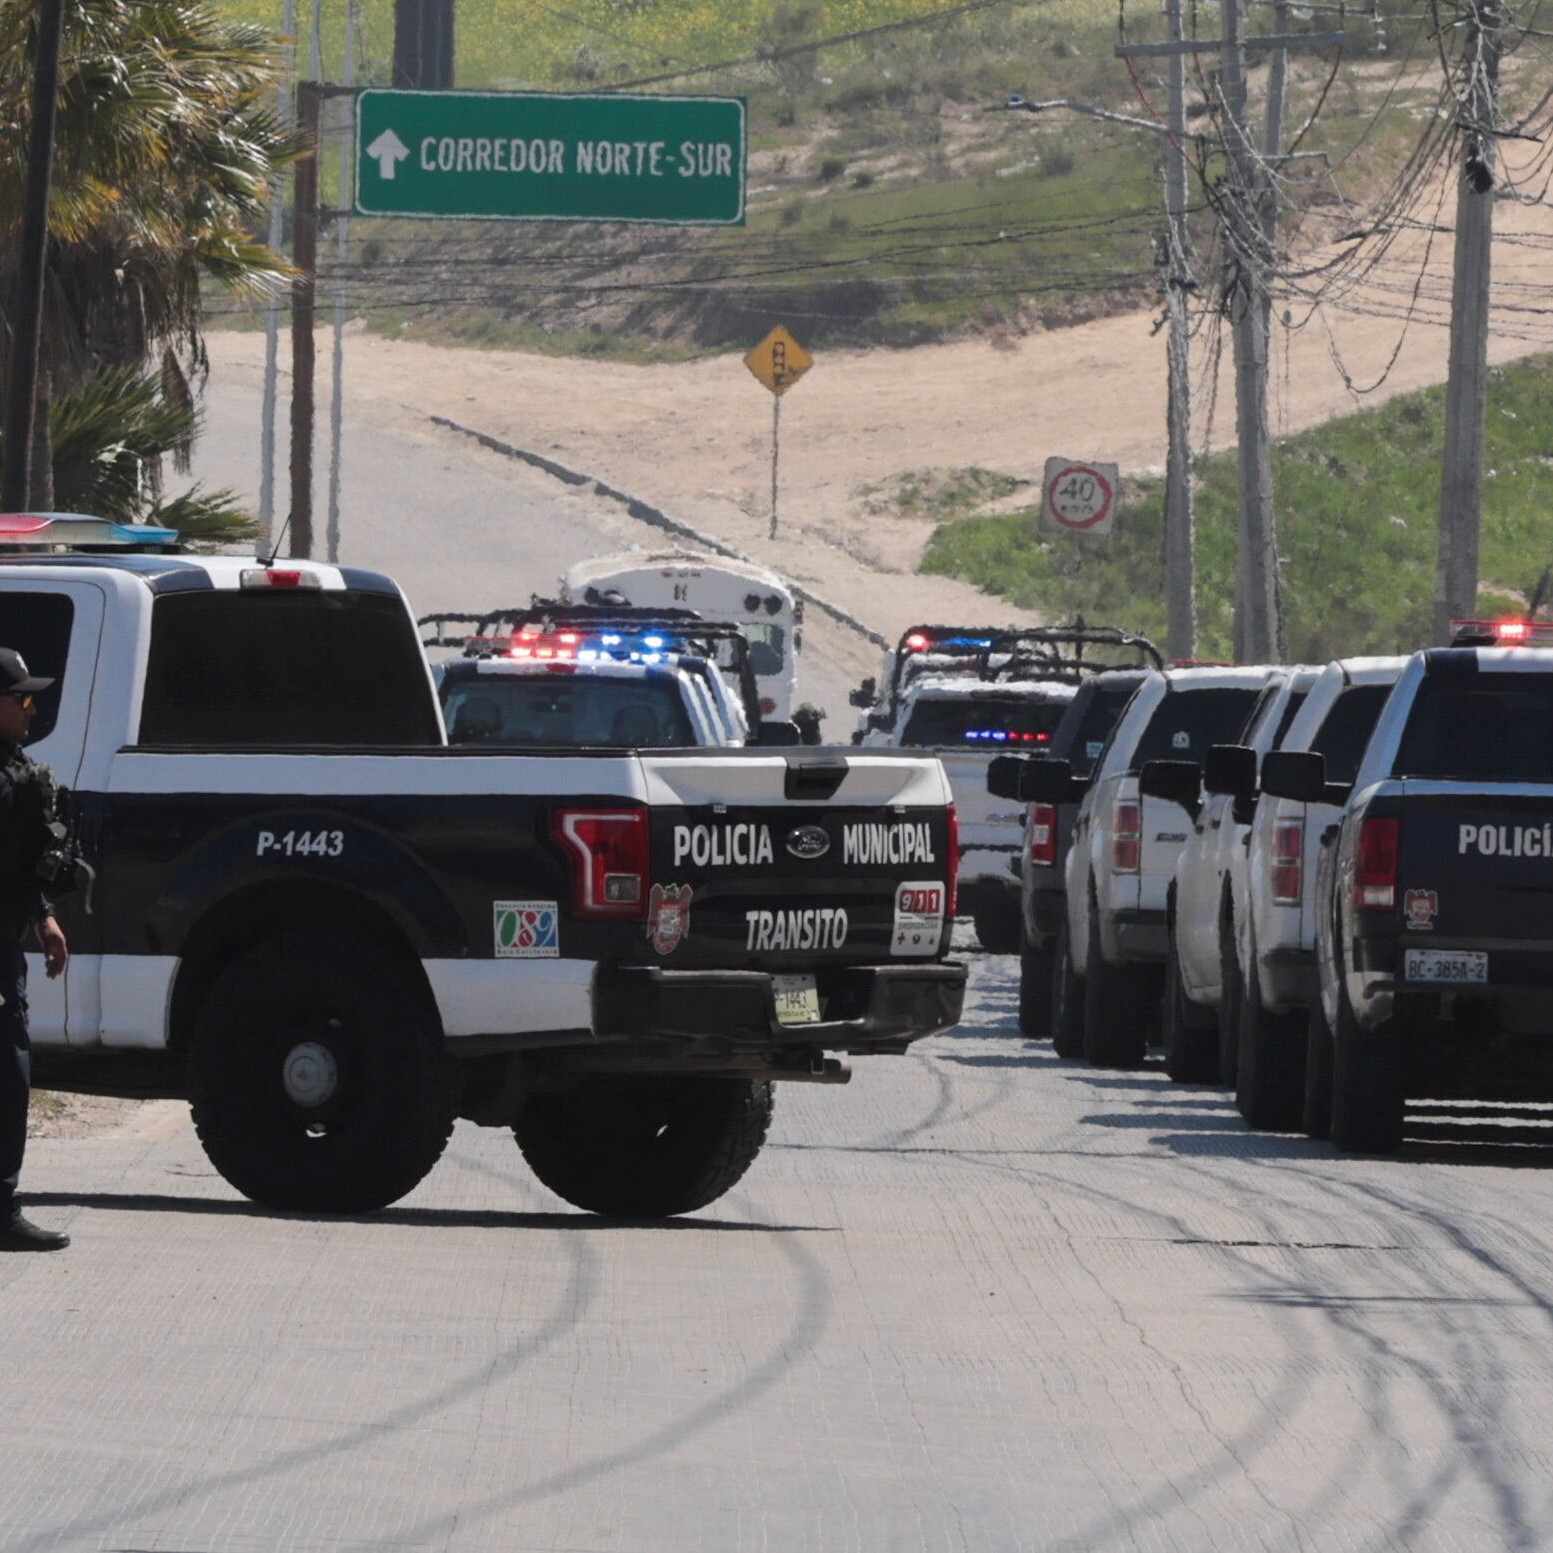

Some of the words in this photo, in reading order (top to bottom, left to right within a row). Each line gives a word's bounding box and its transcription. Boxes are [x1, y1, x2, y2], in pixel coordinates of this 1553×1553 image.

[420, 135, 565, 175] CORREDOR
[576, 139, 733, 178] NORTE-SUR
[1060, 477, 1095, 502] 40
[256, 830, 344, 856] P-1443
[674, 823, 774, 867] POLICIA
[843, 823, 936, 866] MUNICIPAL
[901, 891, 938, 911] 911
[497, 910, 555, 949] 089
[746, 908, 847, 951] TRANSITO
